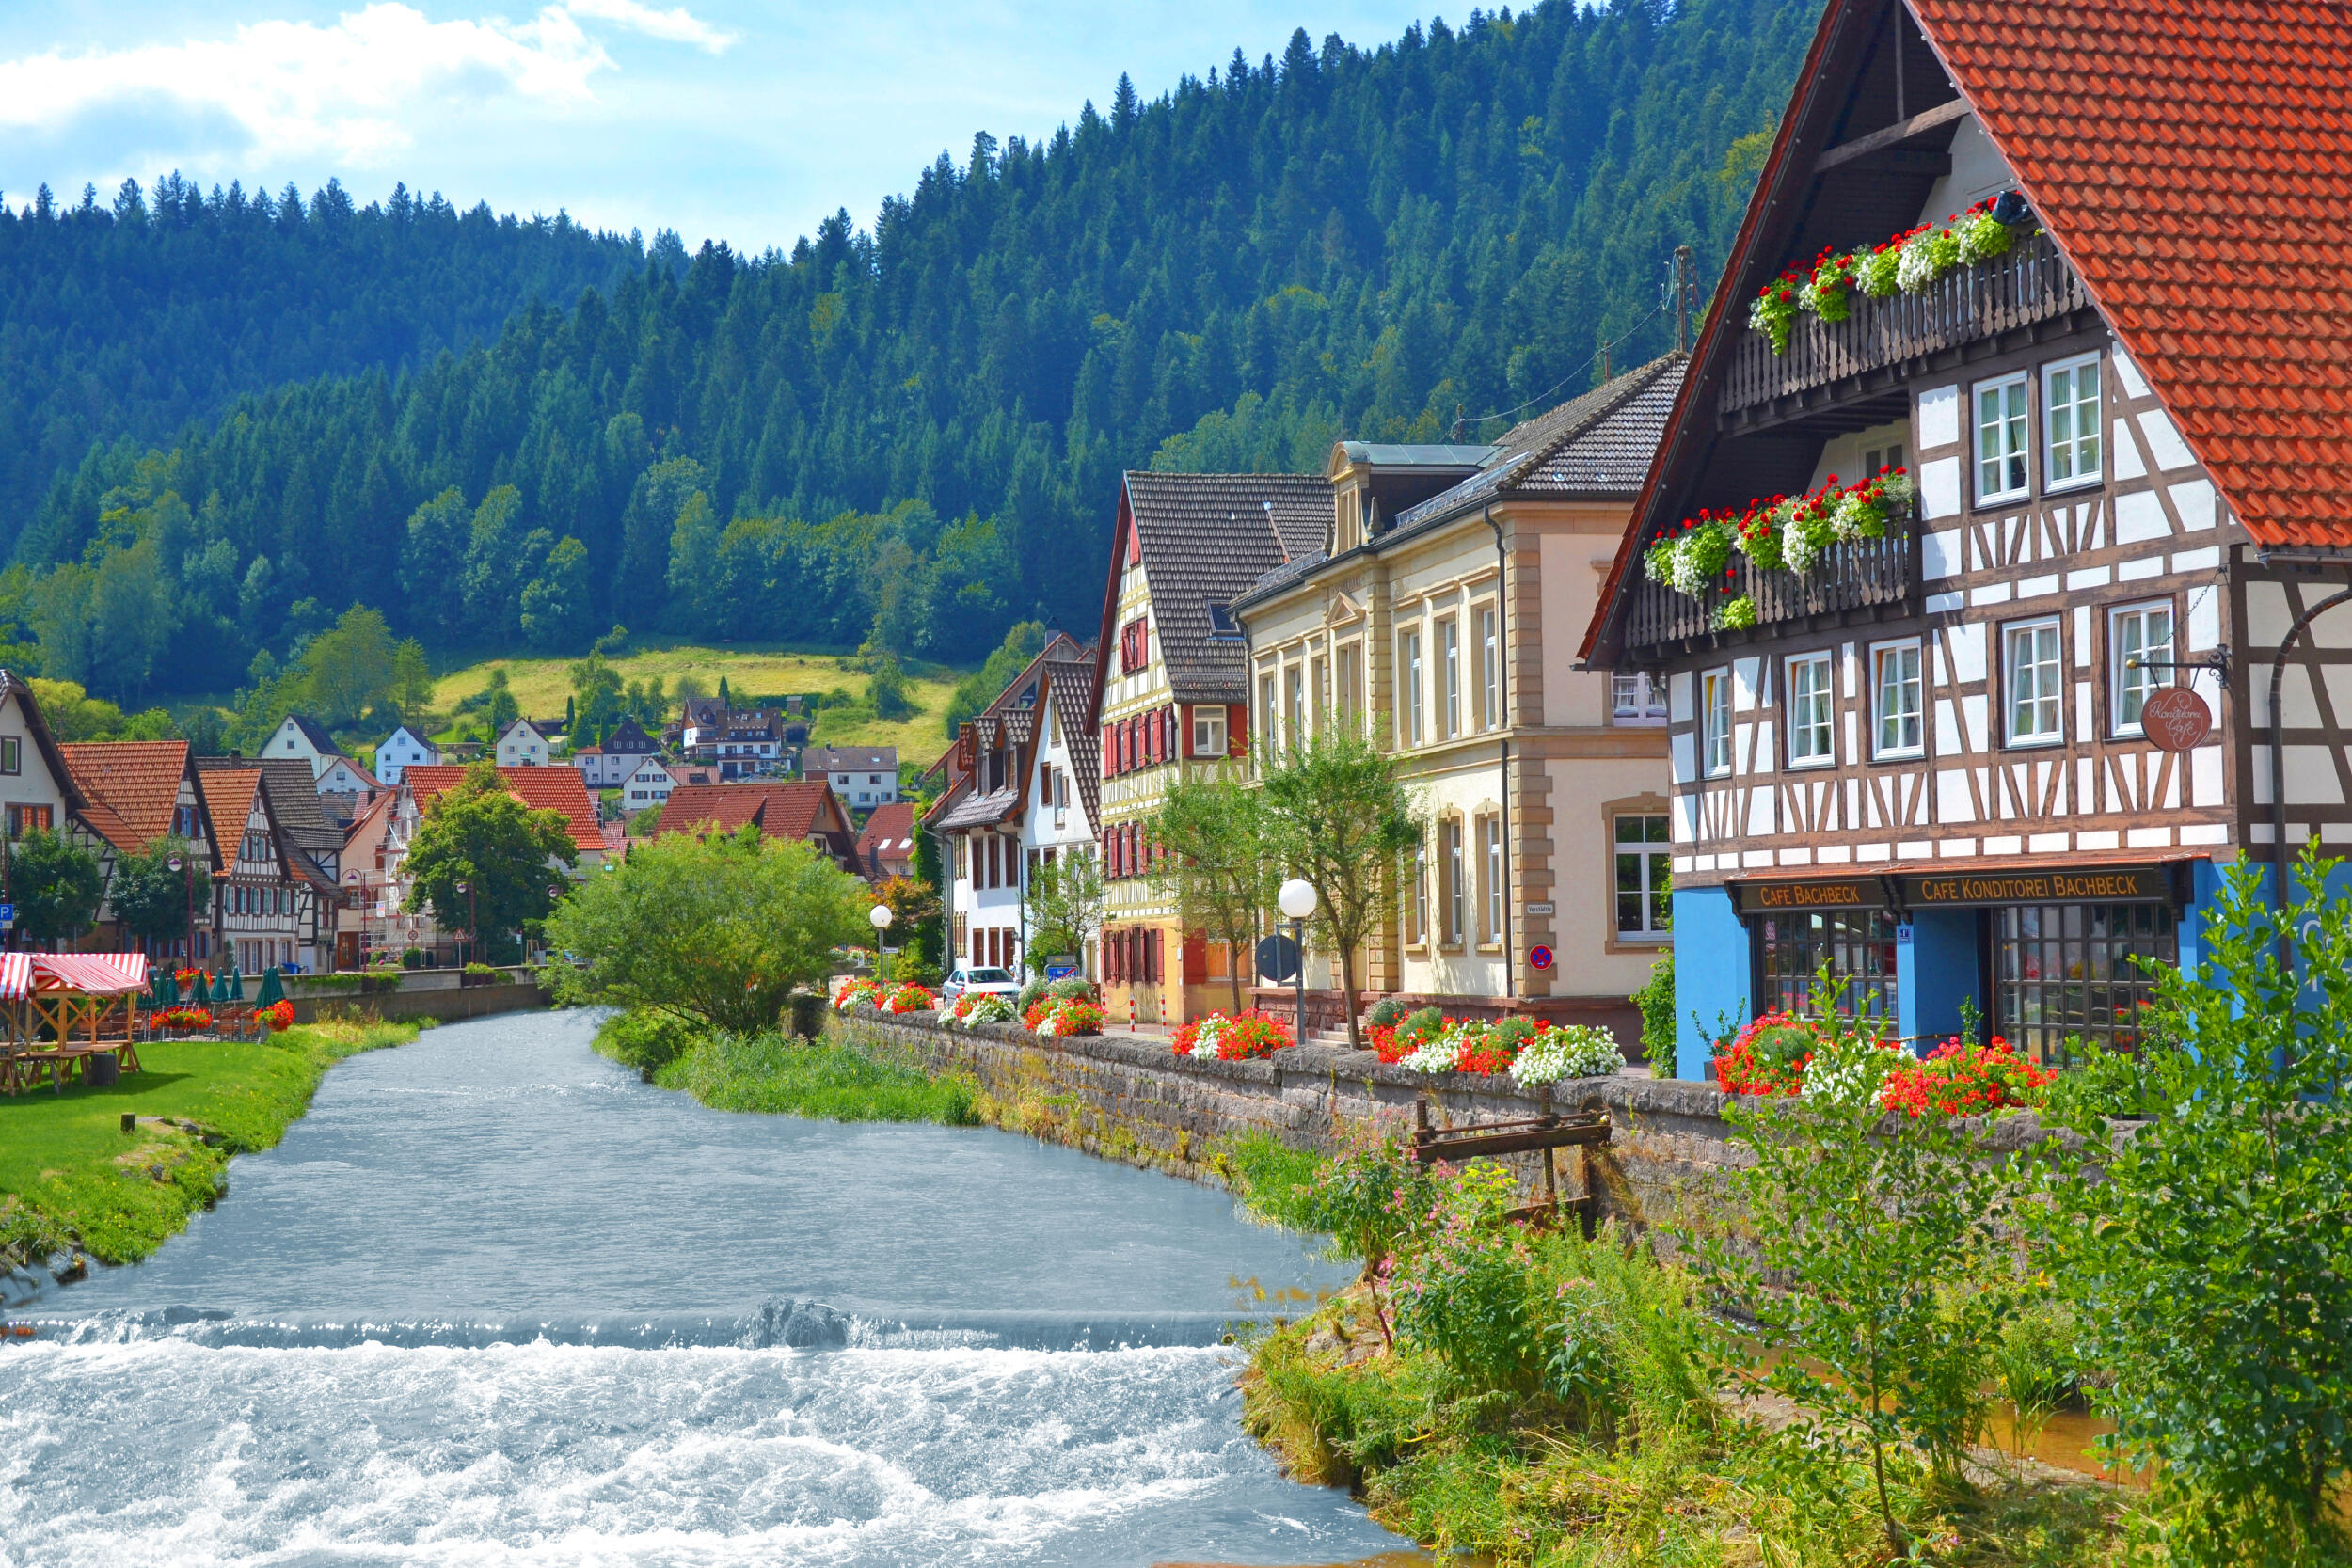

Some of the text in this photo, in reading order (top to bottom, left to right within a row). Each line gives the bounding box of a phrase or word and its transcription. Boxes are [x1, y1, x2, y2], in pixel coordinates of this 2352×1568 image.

[1793, 885, 1860, 905] BACHBECK
[1962, 878, 2049, 899] KONDITOREI
[2053, 875, 2138, 896] BACHBECK
[0, 906, 9, 919] P
